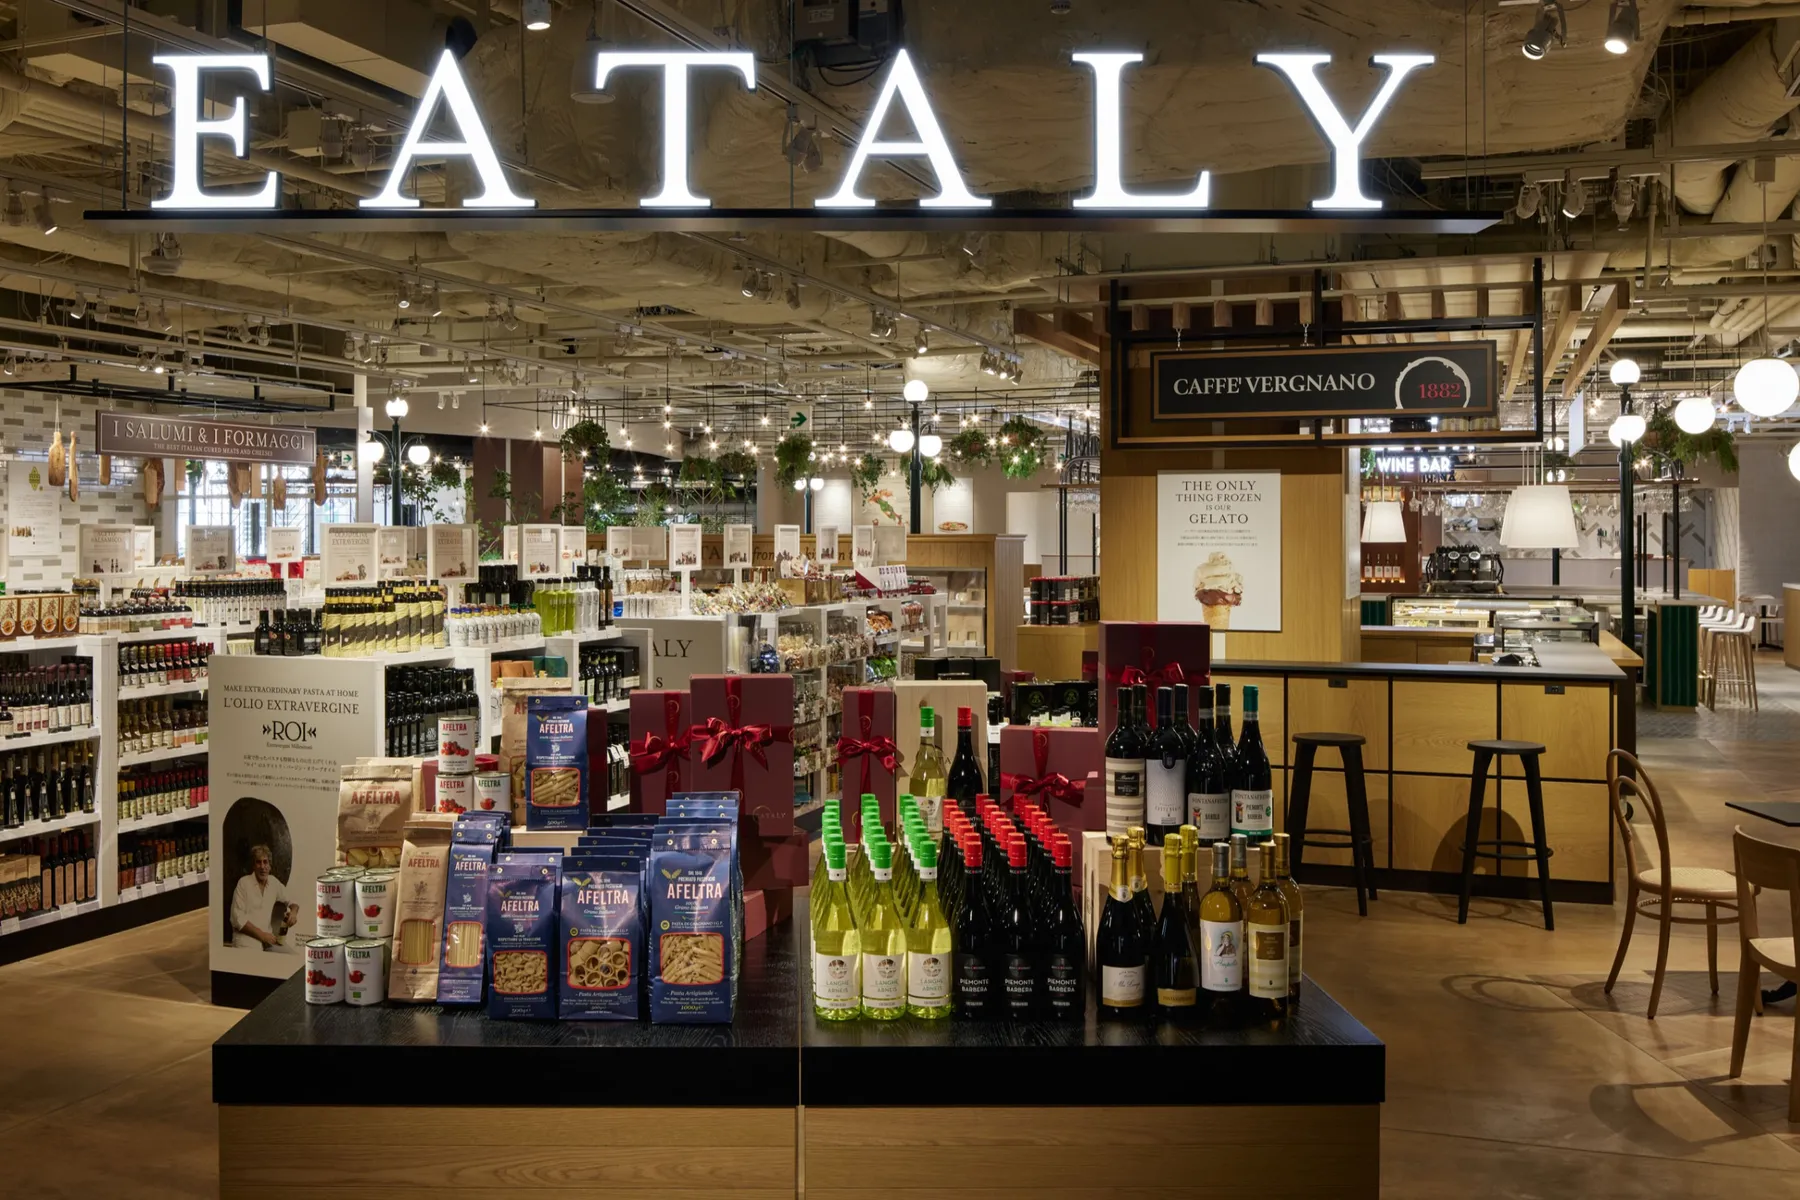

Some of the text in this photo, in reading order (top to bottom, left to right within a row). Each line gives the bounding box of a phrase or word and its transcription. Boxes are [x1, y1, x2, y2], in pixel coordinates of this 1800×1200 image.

[152, 48, 1435, 208] EATALY
[1242, 372, 1376, 394] VERGNANO
[1418, 382, 1461, 400] 1882
[113, 420, 306, 450] I SALUMI & I FORMAGGI
[1376, 456, 1451, 473] WINE BAR
[1182, 480, 1256, 491] THE ONLY
[1175, 493, 1262, 502] THING FROZEN
[1189, 513, 1249, 524] GELATO
[223, 684, 243, 693] MAKE
[244, 685, 301, 695] EXTRAORDINARY
[303, 688, 325, 696] PASTA
[337, 690, 359, 698] HOME
[223, 698, 360, 714] L'OLIO EXTRAVERGINE
[442, 723, 467, 732] AFELTRA
[539, 723, 574, 734] AFELTRA
[440, 781, 465, 789] AFELTRA
[478, 780, 501, 788] AFELTRA
[350, 790, 401, 805] AFELTRA
[408, 858, 440, 868] AFELTRA
[455, 861, 487, 871] AFELTRA
[317, 885, 341, 894] AFELTRA
[361, 884, 387, 893] AFELTRA
[667, 883, 723, 899] AFELTRA
[577, 890, 629, 905] AFELTRA
[501, 900, 540, 912] AFELTRA
[307, 949, 334, 960] AFELTRA
[347, 949, 371, 960] AFELTRA
[960, 978, 989, 986] PIEMONTE
[1005, 978, 1034, 986] PIEMONTE
[1049, 985, 1075, 993] BARBERA
